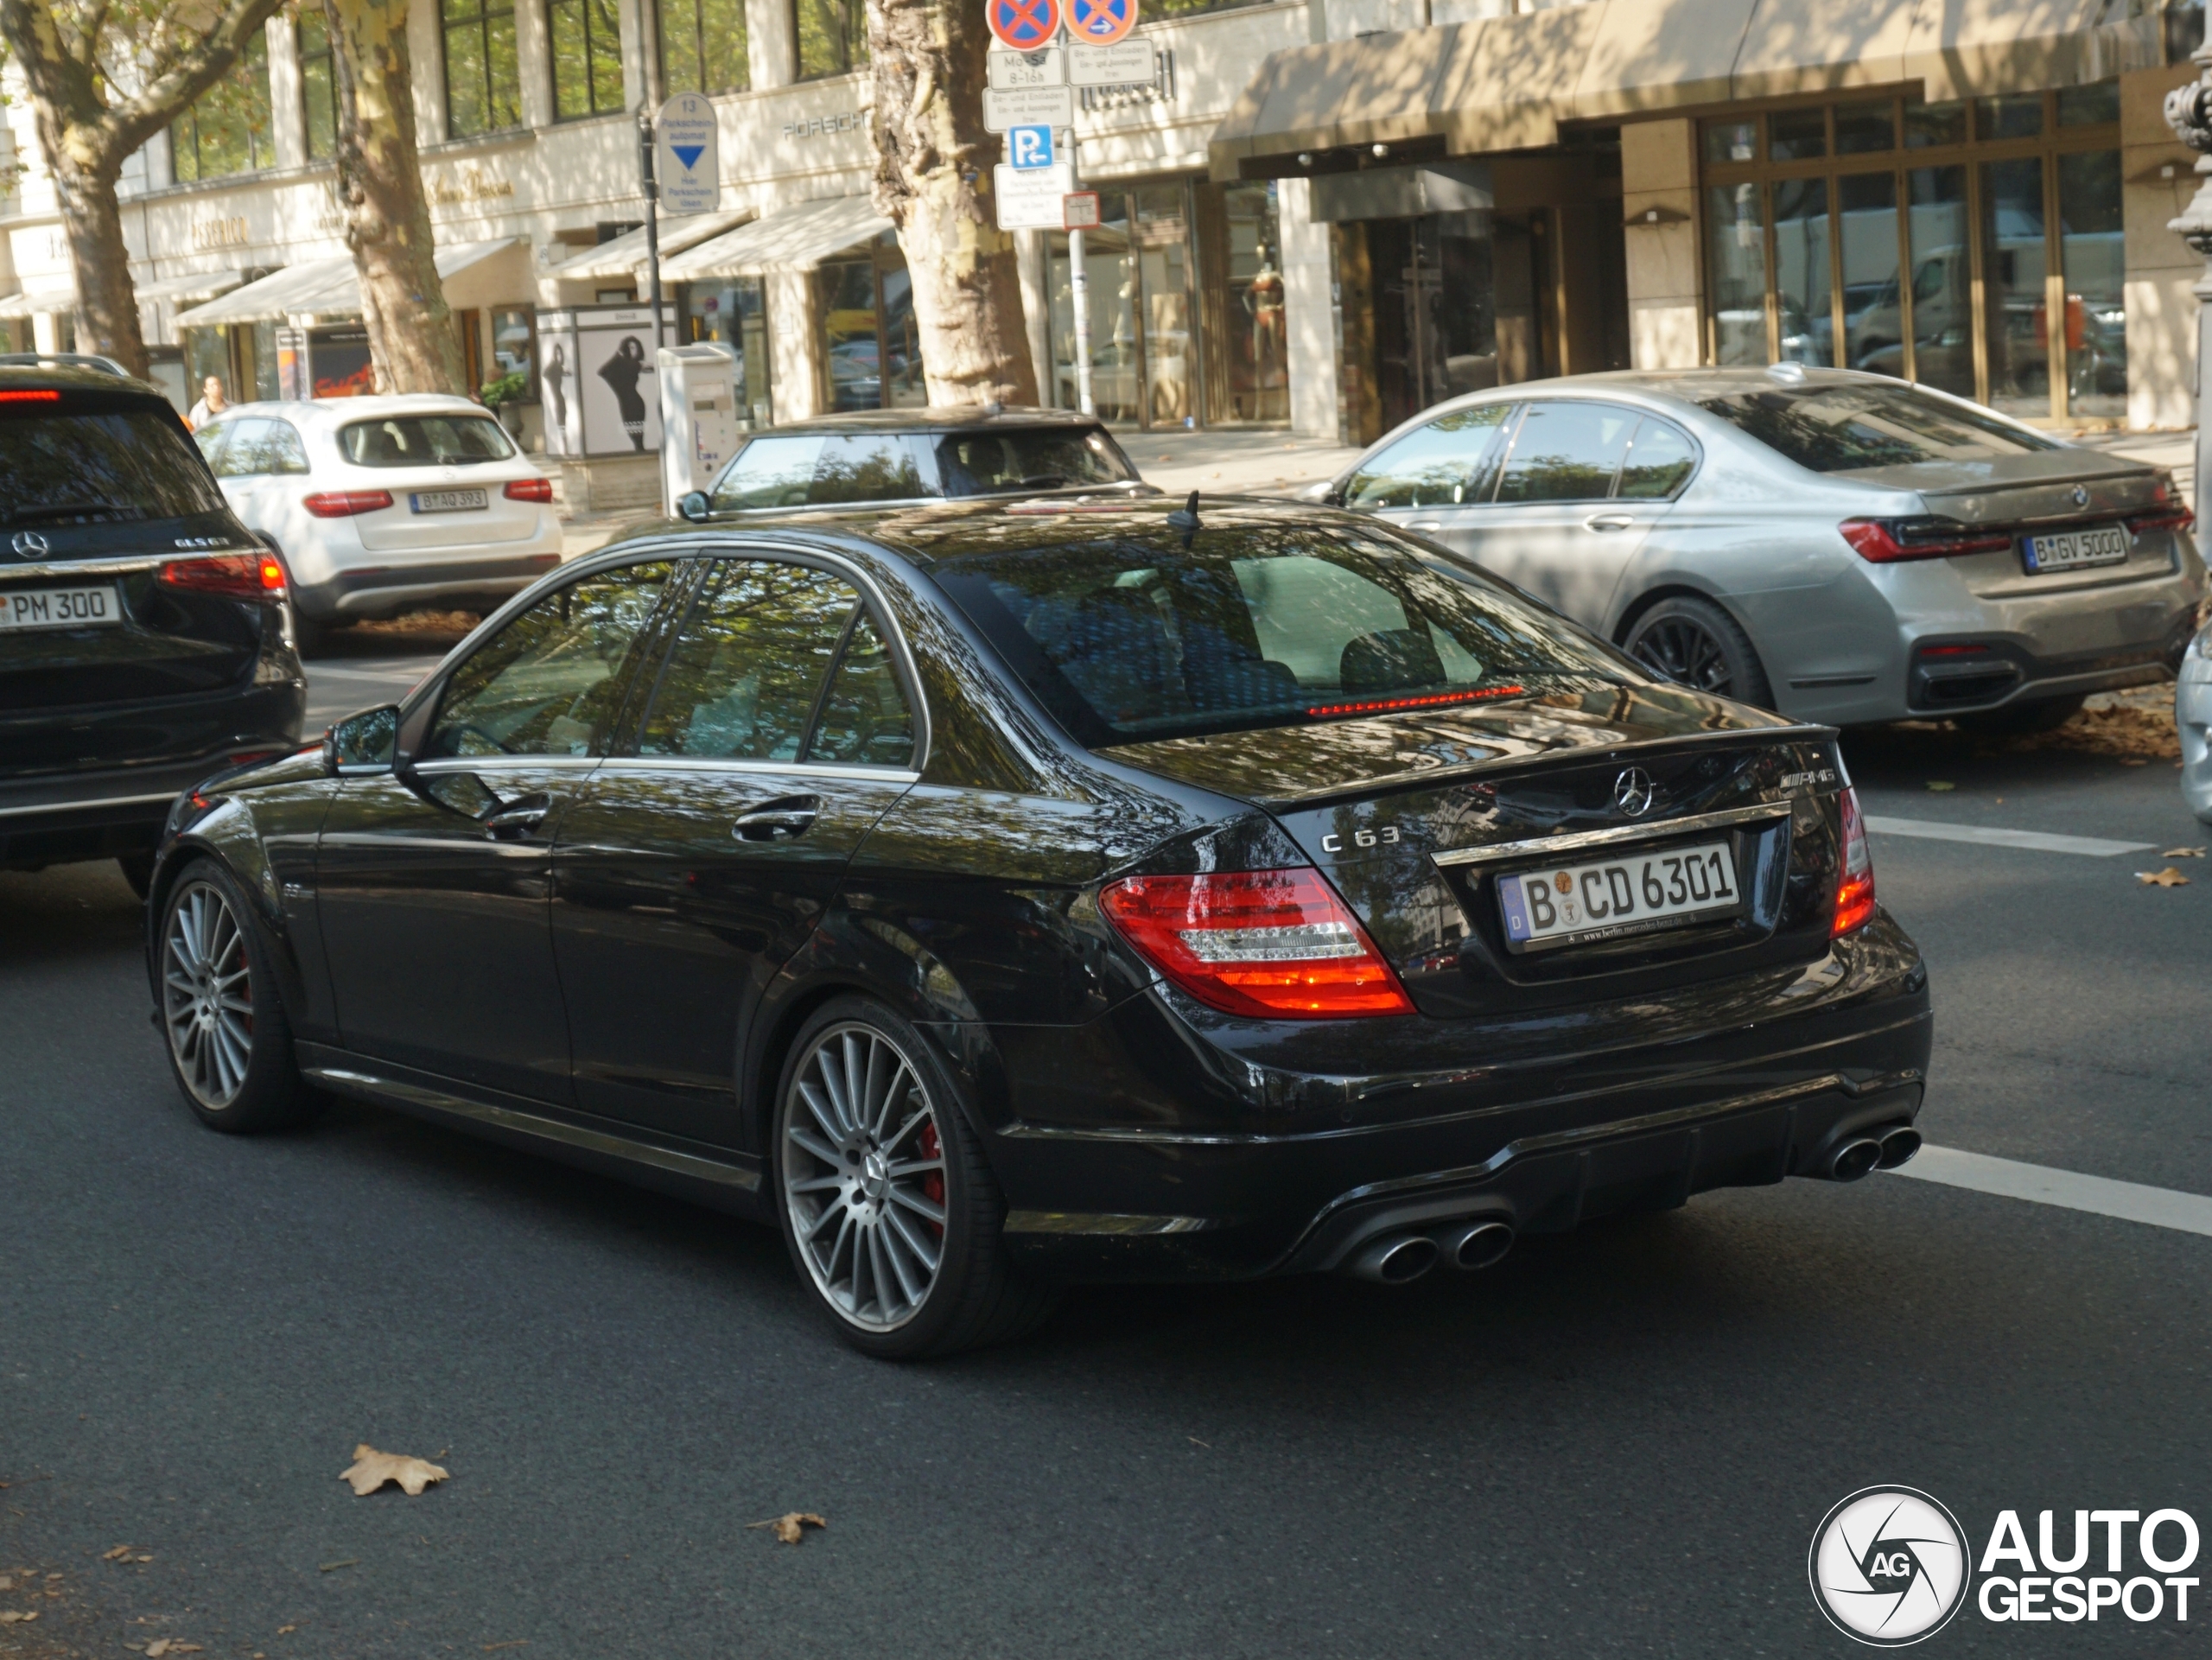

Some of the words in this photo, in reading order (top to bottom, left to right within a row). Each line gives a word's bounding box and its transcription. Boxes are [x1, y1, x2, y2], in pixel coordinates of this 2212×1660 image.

[1110, 45, 1147, 55] Entladen
[682, 100, 696, 113] 13
[1028, 92, 1065, 100] Entladen
[783, 112, 864, 140] PORSCH
[1014, 130, 1040, 164] P
[668, 188, 713, 196] Parkschein
[423, 494, 431, 508] B
[441, 493, 456, 506] AQ
[459, 492, 481, 505] 393
[175, 537, 207, 548] GLS
[2036, 540, 2048, 563] B
[2057, 537, 2078, 560] GV
[2081, 531, 2121, 557] 5000
[12, 595, 50, 622] PM
[55, 591, 106, 620] 300
[1321, 833, 1343, 853] C
[1354, 826, 1400, 848] 63
[1526, 880, 1557, 930] B
[1580, 867, 1635, 919] CD
[1642, 852, 1733, 909] 6301
[1583, 916, 1683, 942] www.berlin.mercedes-benz.de
